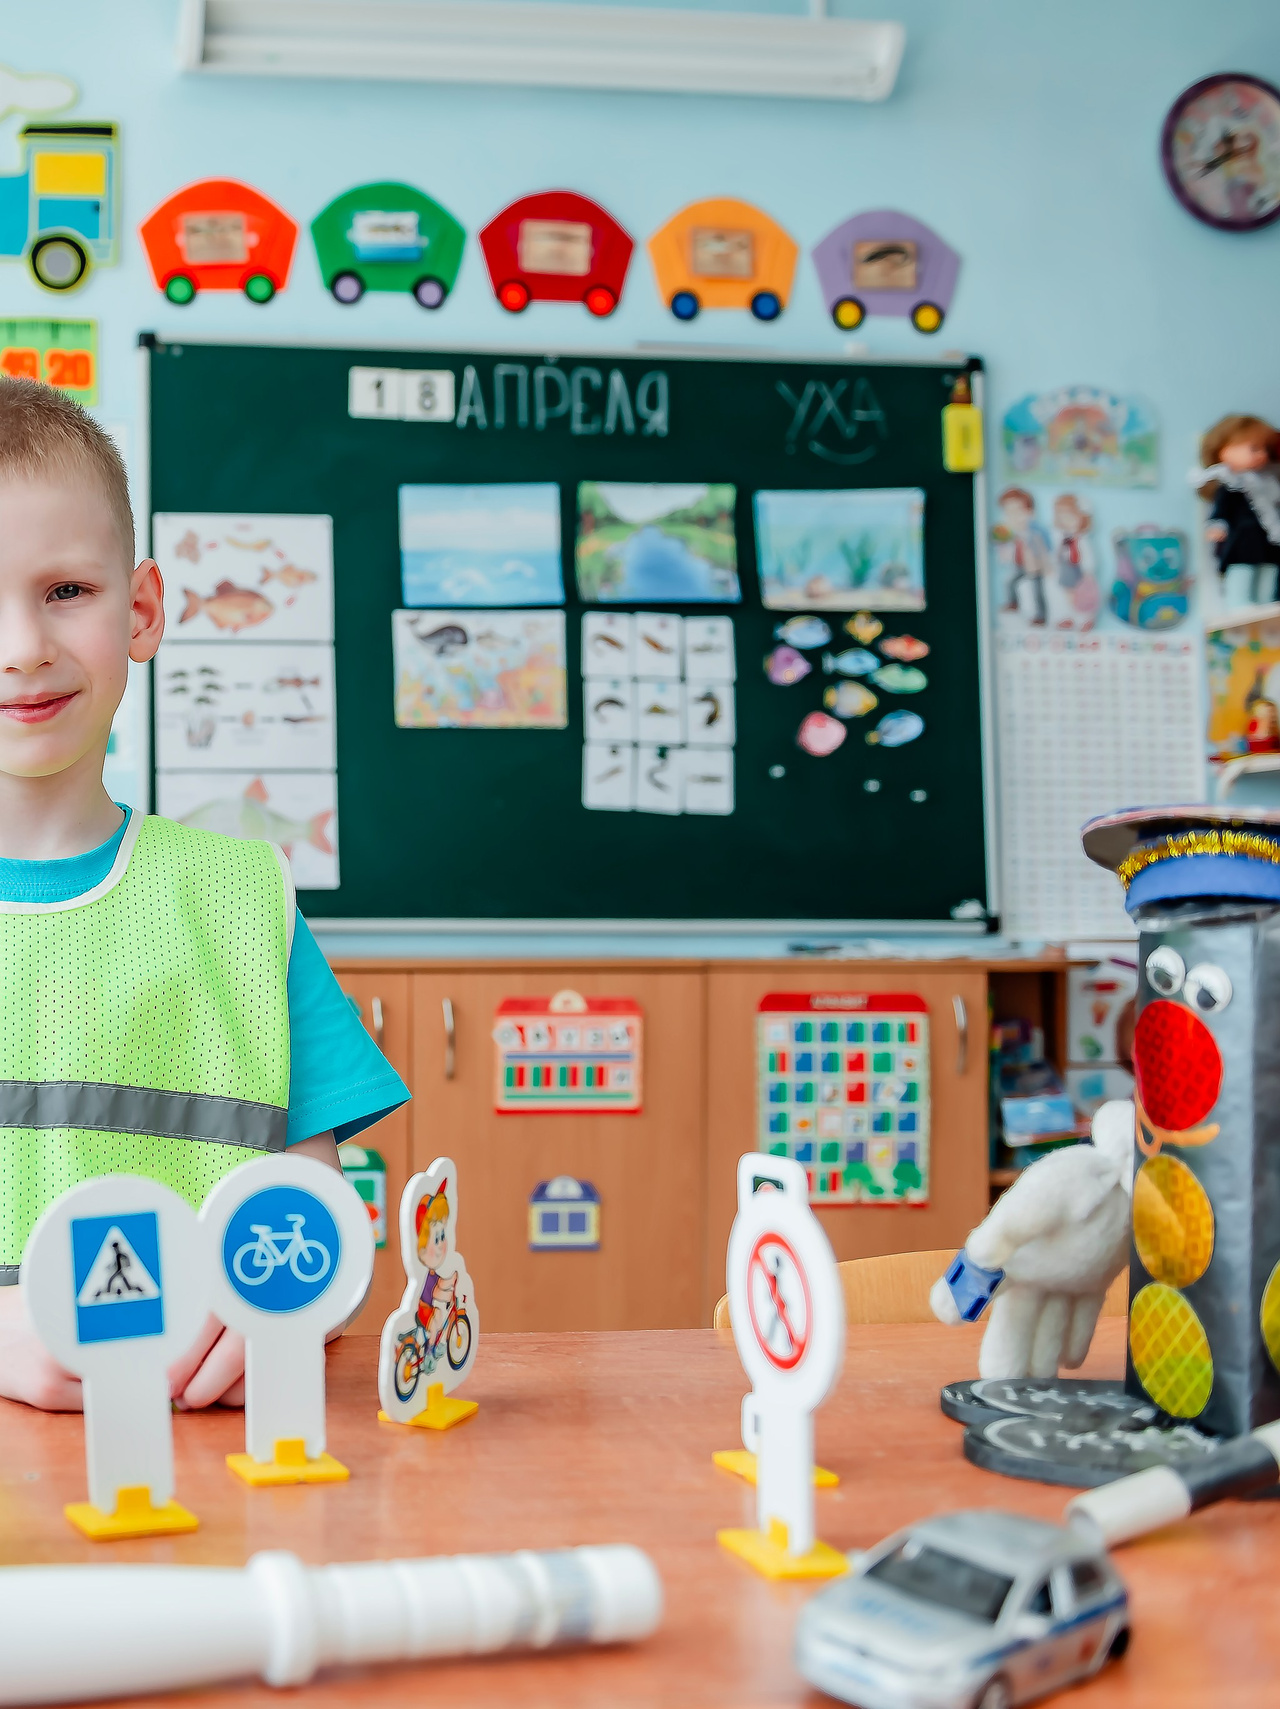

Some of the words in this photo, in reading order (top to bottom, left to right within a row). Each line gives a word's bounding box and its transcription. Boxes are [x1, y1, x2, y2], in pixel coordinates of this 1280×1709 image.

[44, 348, 95, 390] 20
[456, 363, 669, 438] АПРЕЛЯ
[775, 377, 890, 447] УХА
